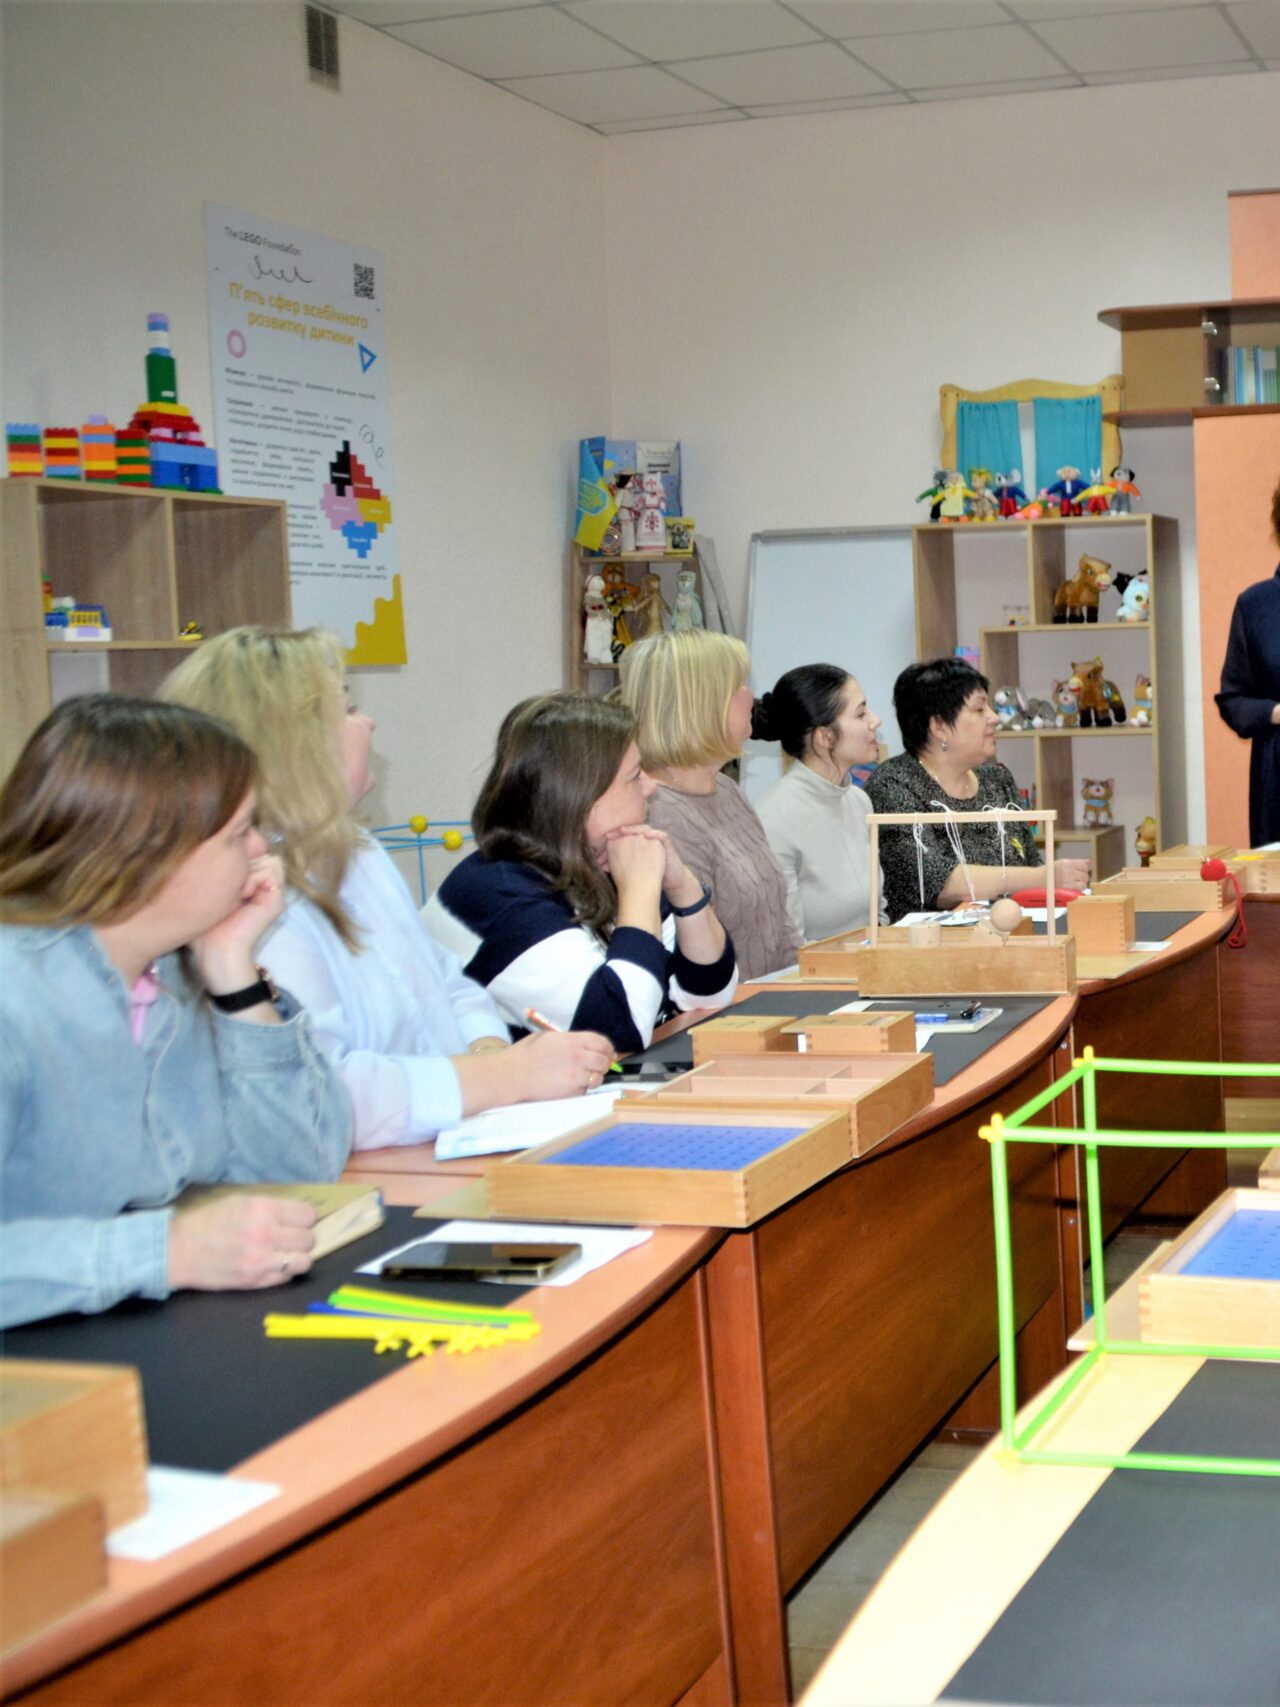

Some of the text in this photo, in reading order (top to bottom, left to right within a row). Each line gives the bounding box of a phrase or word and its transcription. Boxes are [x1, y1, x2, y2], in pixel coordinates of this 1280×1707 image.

[238, 230, 262, 246] LEGO
[248, 311, 355, 346] розвитку дитини
[268, 293, 300, 316] сфер
[303, 303, 369, 331] всебічного
